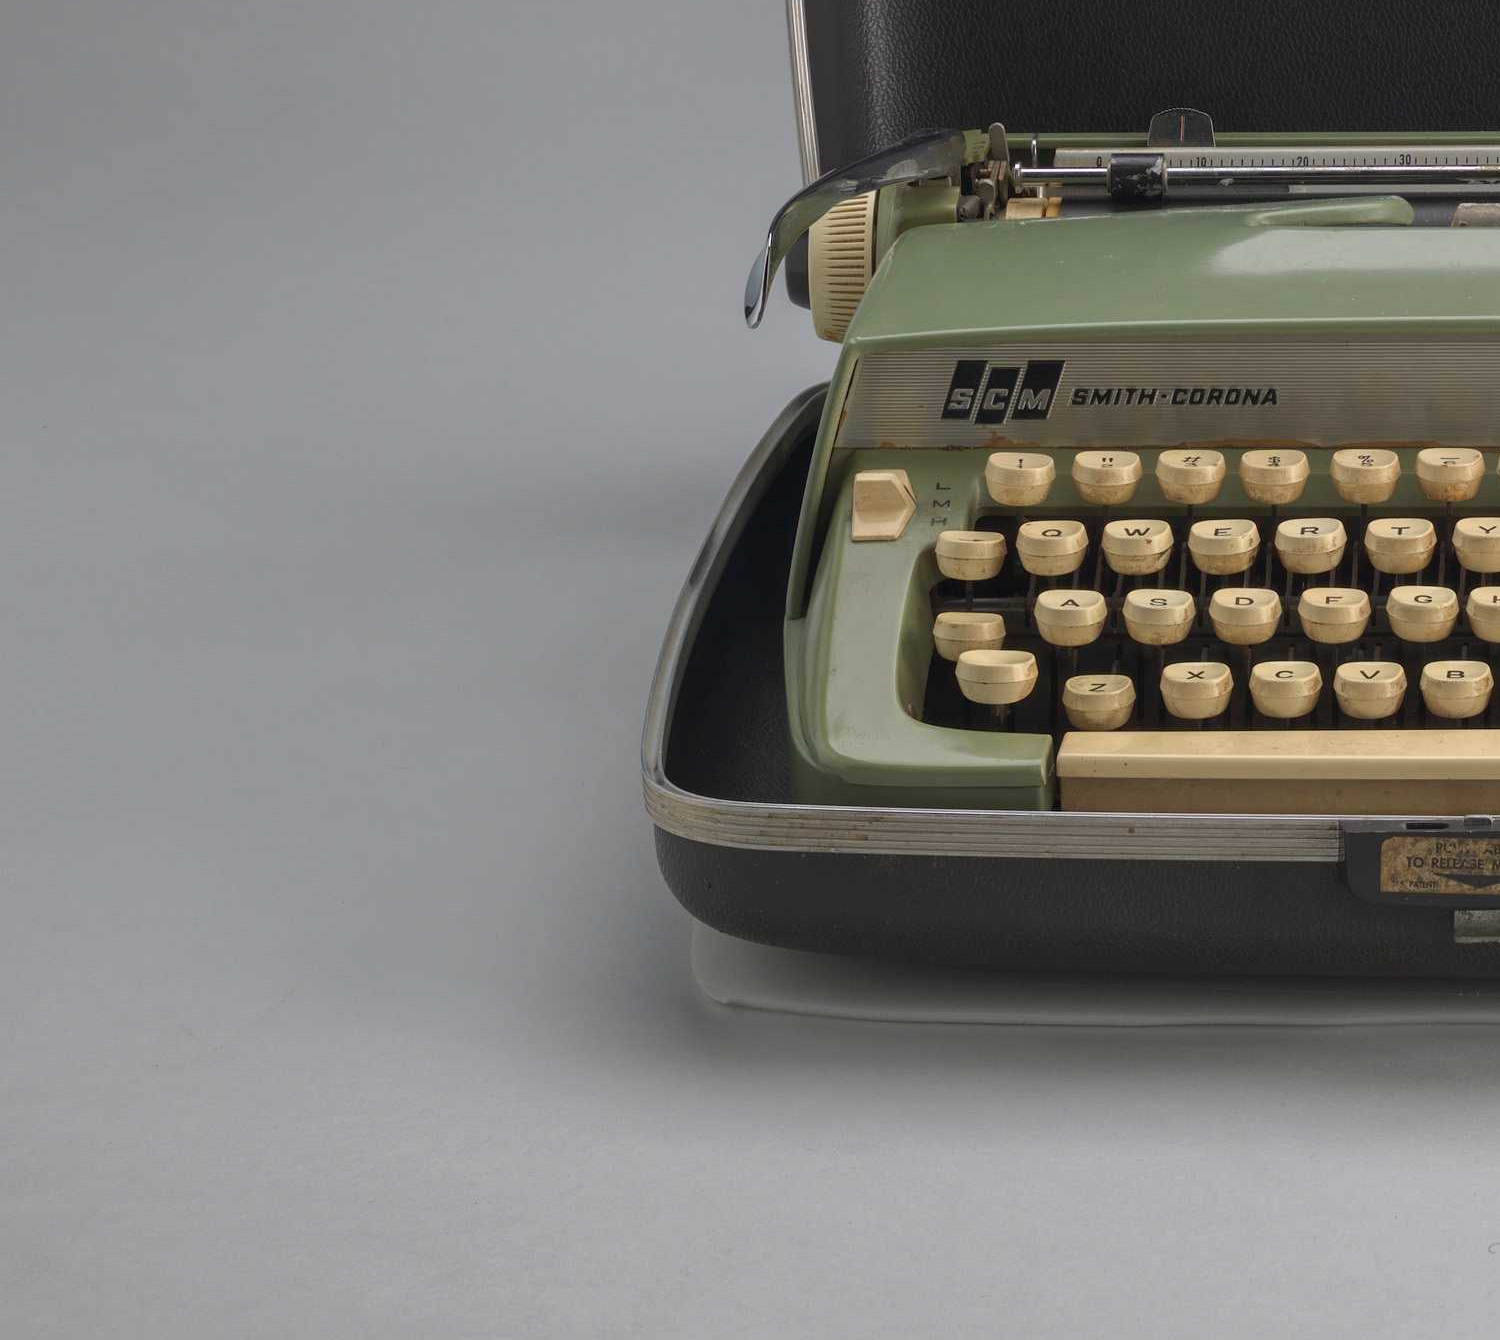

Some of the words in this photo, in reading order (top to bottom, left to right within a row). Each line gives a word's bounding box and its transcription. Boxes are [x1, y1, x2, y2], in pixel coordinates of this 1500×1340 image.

[1297, 156, 1309, 167] 20
[1399, 154, 1412, 166] 30
[932, 500, 951, 508] M
[1041, 528, 1063, 538] Q
[1124, 527, 1151, 537] W
[1213, 527, 1233, 537] E
[1299, 526, 1320, 536] R
[1390, 526, 1411, 536] T
[1478, 525, 1497, 534] Y
[1059, 598, 1081, 608] A
[1149, 598, 1168, 607] S
[1234, 596, 1255, 606] D
[1325, 595, 1343, 605] F
[1413, 594, 1433, 604] G
[1186, 670, 1205, 680] X
[1274, 670, 1294, 679] C
[1359, 670, 1381, 680] V
[1446, 670, 1465, 679] B
[1088, 683, 1107, 693] Z
[1406, 857, 1424, 869] TO
[1431, 857, 1485, 870] RELEASE
